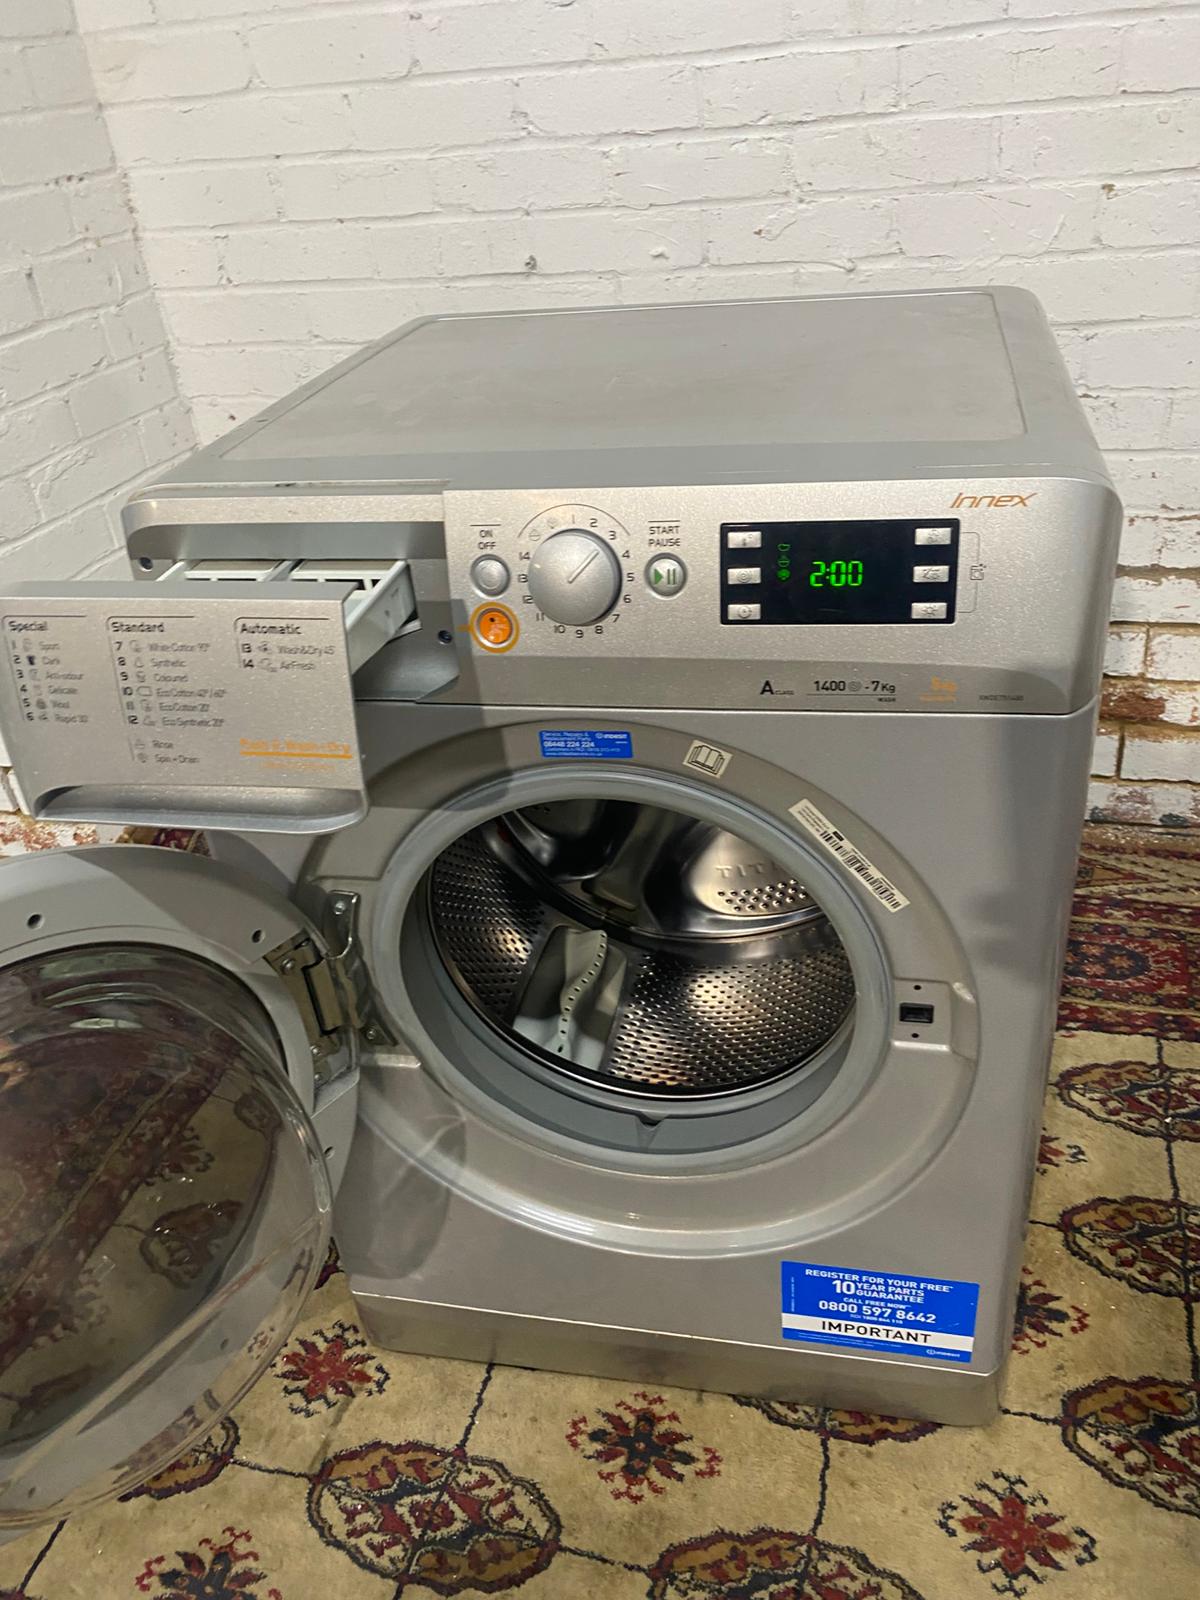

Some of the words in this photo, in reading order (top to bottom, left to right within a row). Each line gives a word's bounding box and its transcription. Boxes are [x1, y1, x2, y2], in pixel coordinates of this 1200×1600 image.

[950, 492, 1038, 509] Innex
[590, 518, 598, 527] 2
[479, 530, 493, 538] ON
[649, 526, 680, 535] START
[609, 531, 617, 540] 3
[478, 542, 496, 550] OFF
[648, 539, 680, 547] PAUSE
[519, 552, 530, 561] 14
[622, 550, 631, 559] 4
[518, 574, 528, 583] 13
[627, 573, 635, 582] 5
[809, 561, 863, 587] 2:00
[523, 595, 533, 604] 12
[624, 595, 632, 604] 6
[536, 613, 545, 622] 11
[612, 614, 620, 624] 7
[8, 621, 47, 632] Special
[111, 622, 165, 632] Standard
[240, 623, 302, 635] Automatic
[554, 625, 566, 634] 10
[595, 626, 604, 635] 8
[575, 630, 584, 639] 9
[115, 641, 122, 650] 7
[242, 643, 252, 653] 13
[13, 655, 21, 664] 2
[118, 656, 126, 666] 8
[242, 659, 255, 668] 14
[16, 669, 23, 679] 3
[120, 672, 128, 681] 9
[20, 684, 27, 692] 4
[123, 687, 133, 695] 10
[760, 680, 774, 695] A
[813, 681, 846, 692] 1400
[23, 698, 30, 707] 5
[26, 712, 33, 721] 6
[128, 715, 138, 725] 12
[805, 1268, 859, 1281] REGISTER
[862, 1275, 884, 1284] FOR
[886, 1277, 918, 1288] YOUR
[832, 1279, 855, 1295] 10
[856, 1282, 889, 1292] YEAR
[892, 1286, 924, 1297] PARTS
[856, 1289, 924, 1304] GUARANTEE
[818, 1300, 857, 1313] 0800
[862, 1305, 892, 1318] 597
[896, 1310, 936, 1324] 8642
[821, 1321, 932, 1343] IMPORTANT
